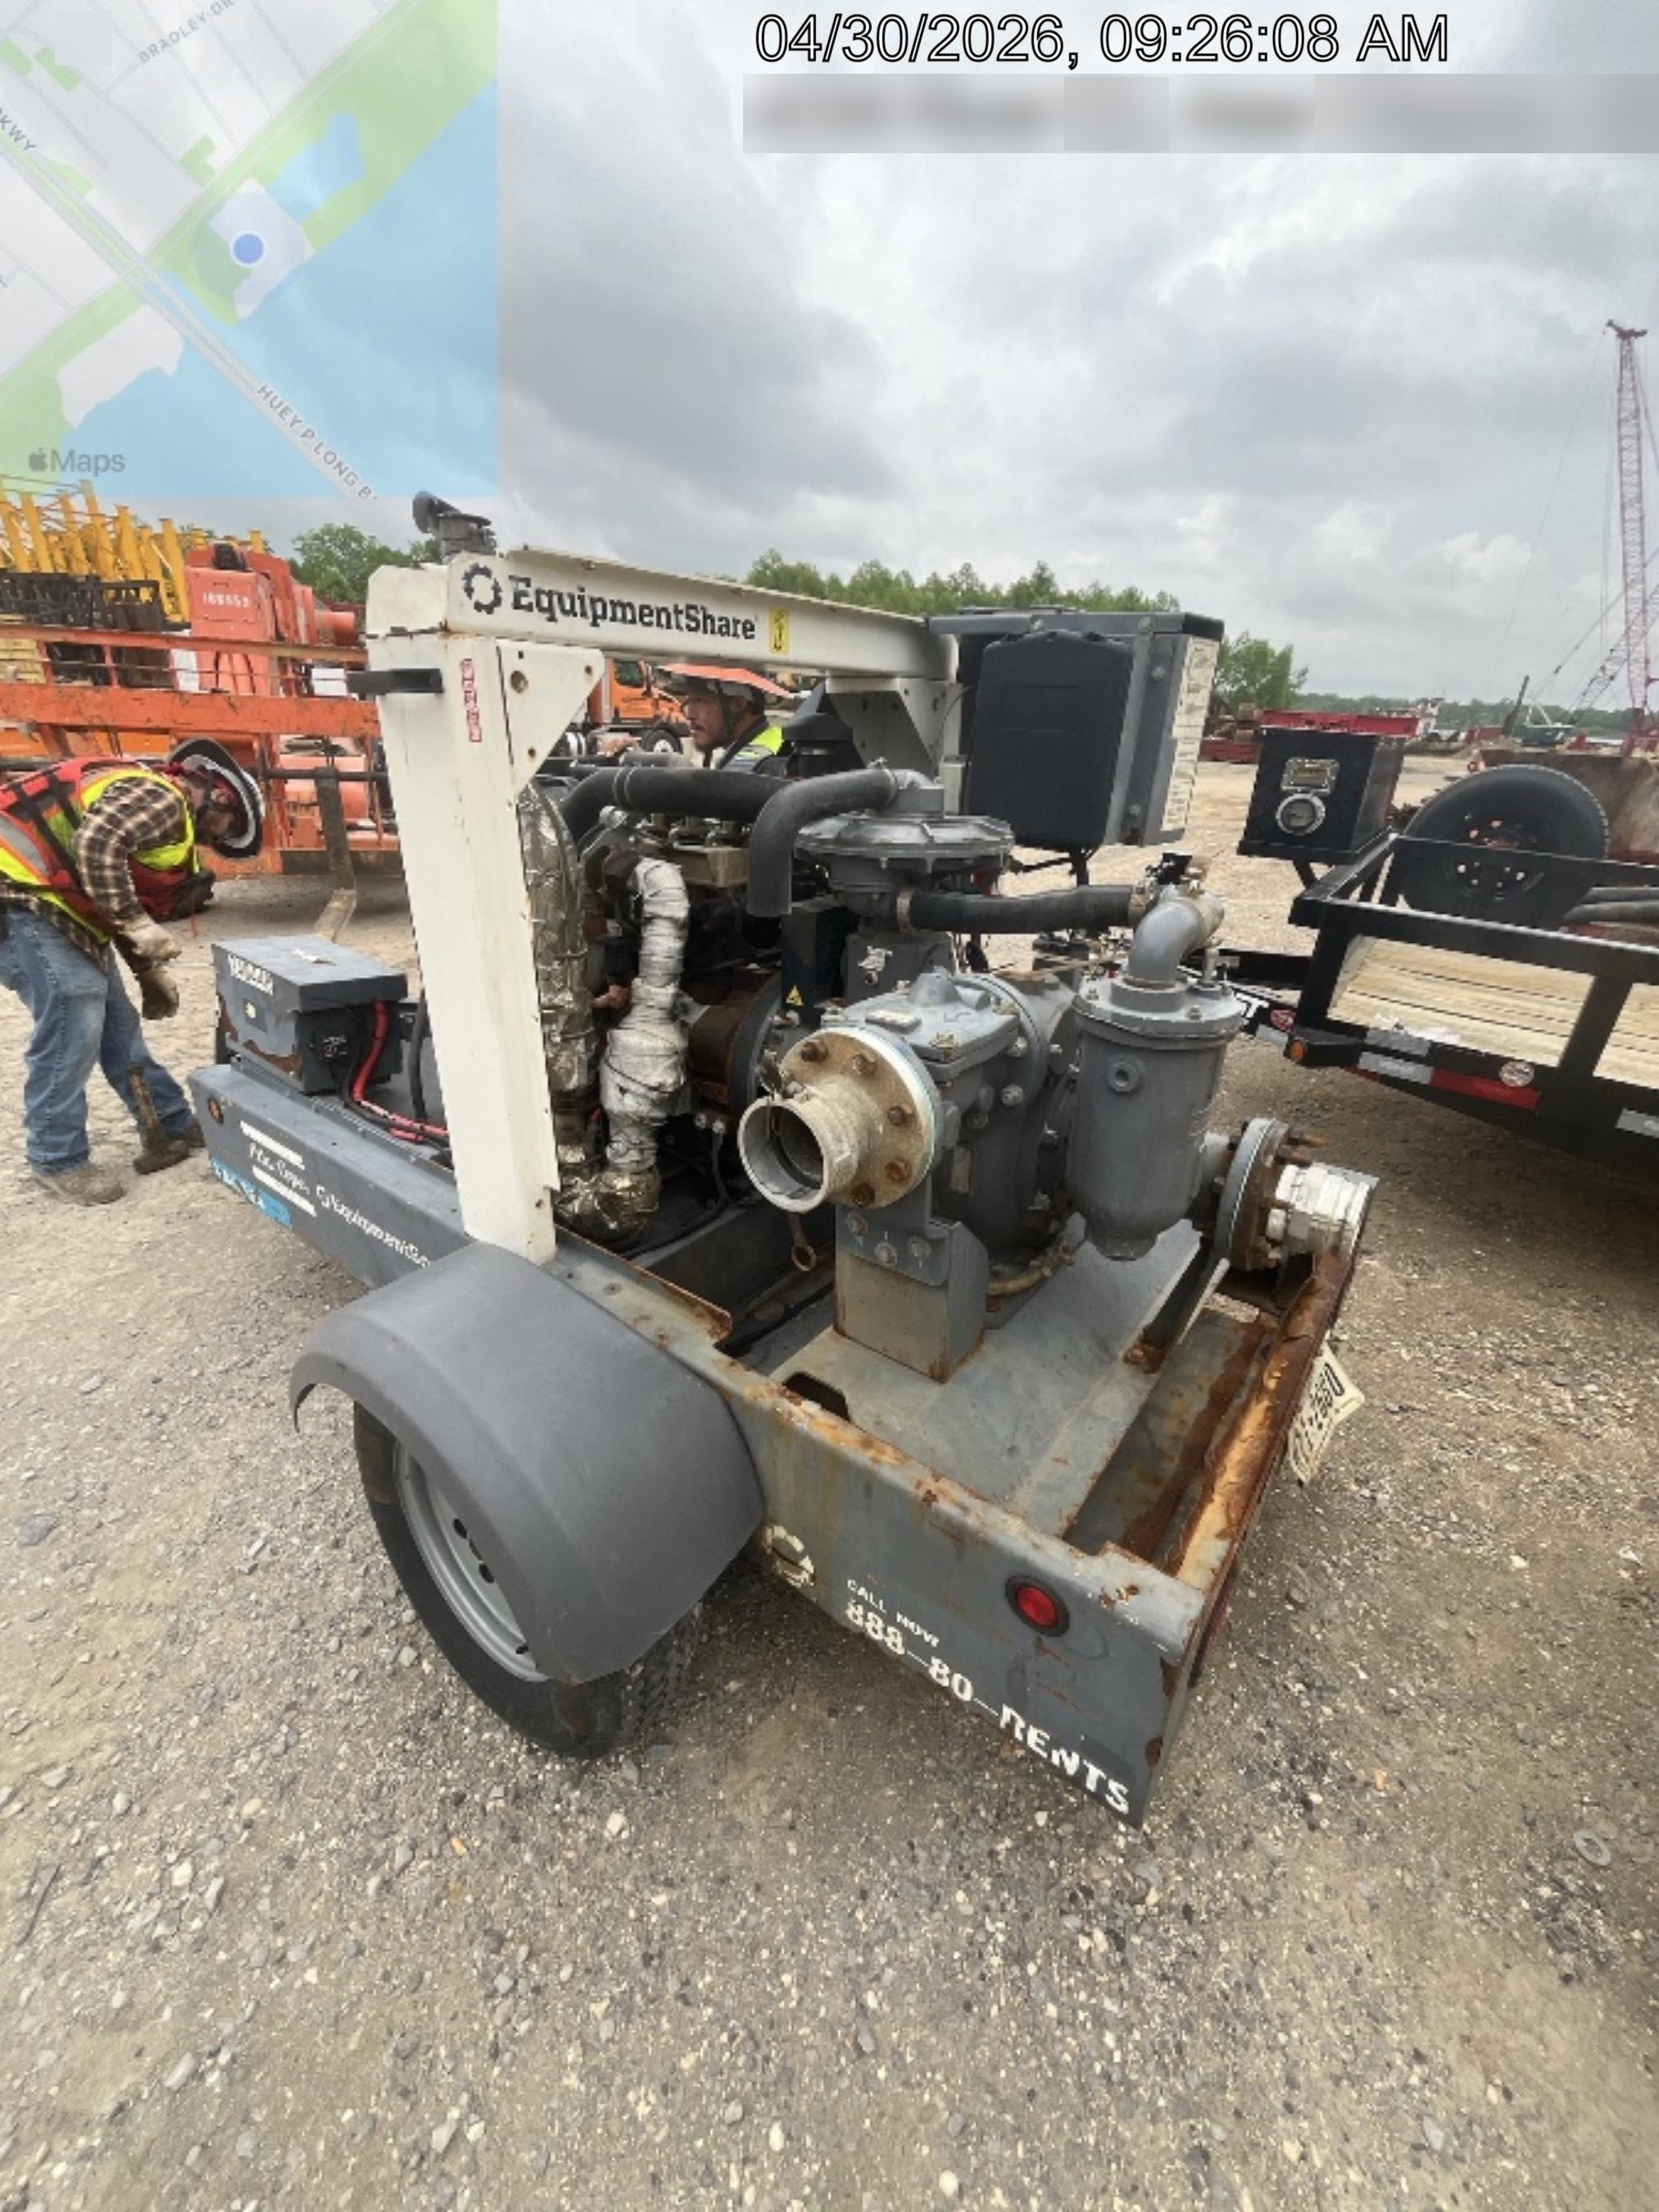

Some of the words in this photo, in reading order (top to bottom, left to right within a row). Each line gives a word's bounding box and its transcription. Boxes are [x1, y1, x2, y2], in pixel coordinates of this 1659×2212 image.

[508, 574, 756, 640] EquipmentShare
[847, 1579, 887, 1615] CALL
[896, 1611, 940, 1648] NOW
